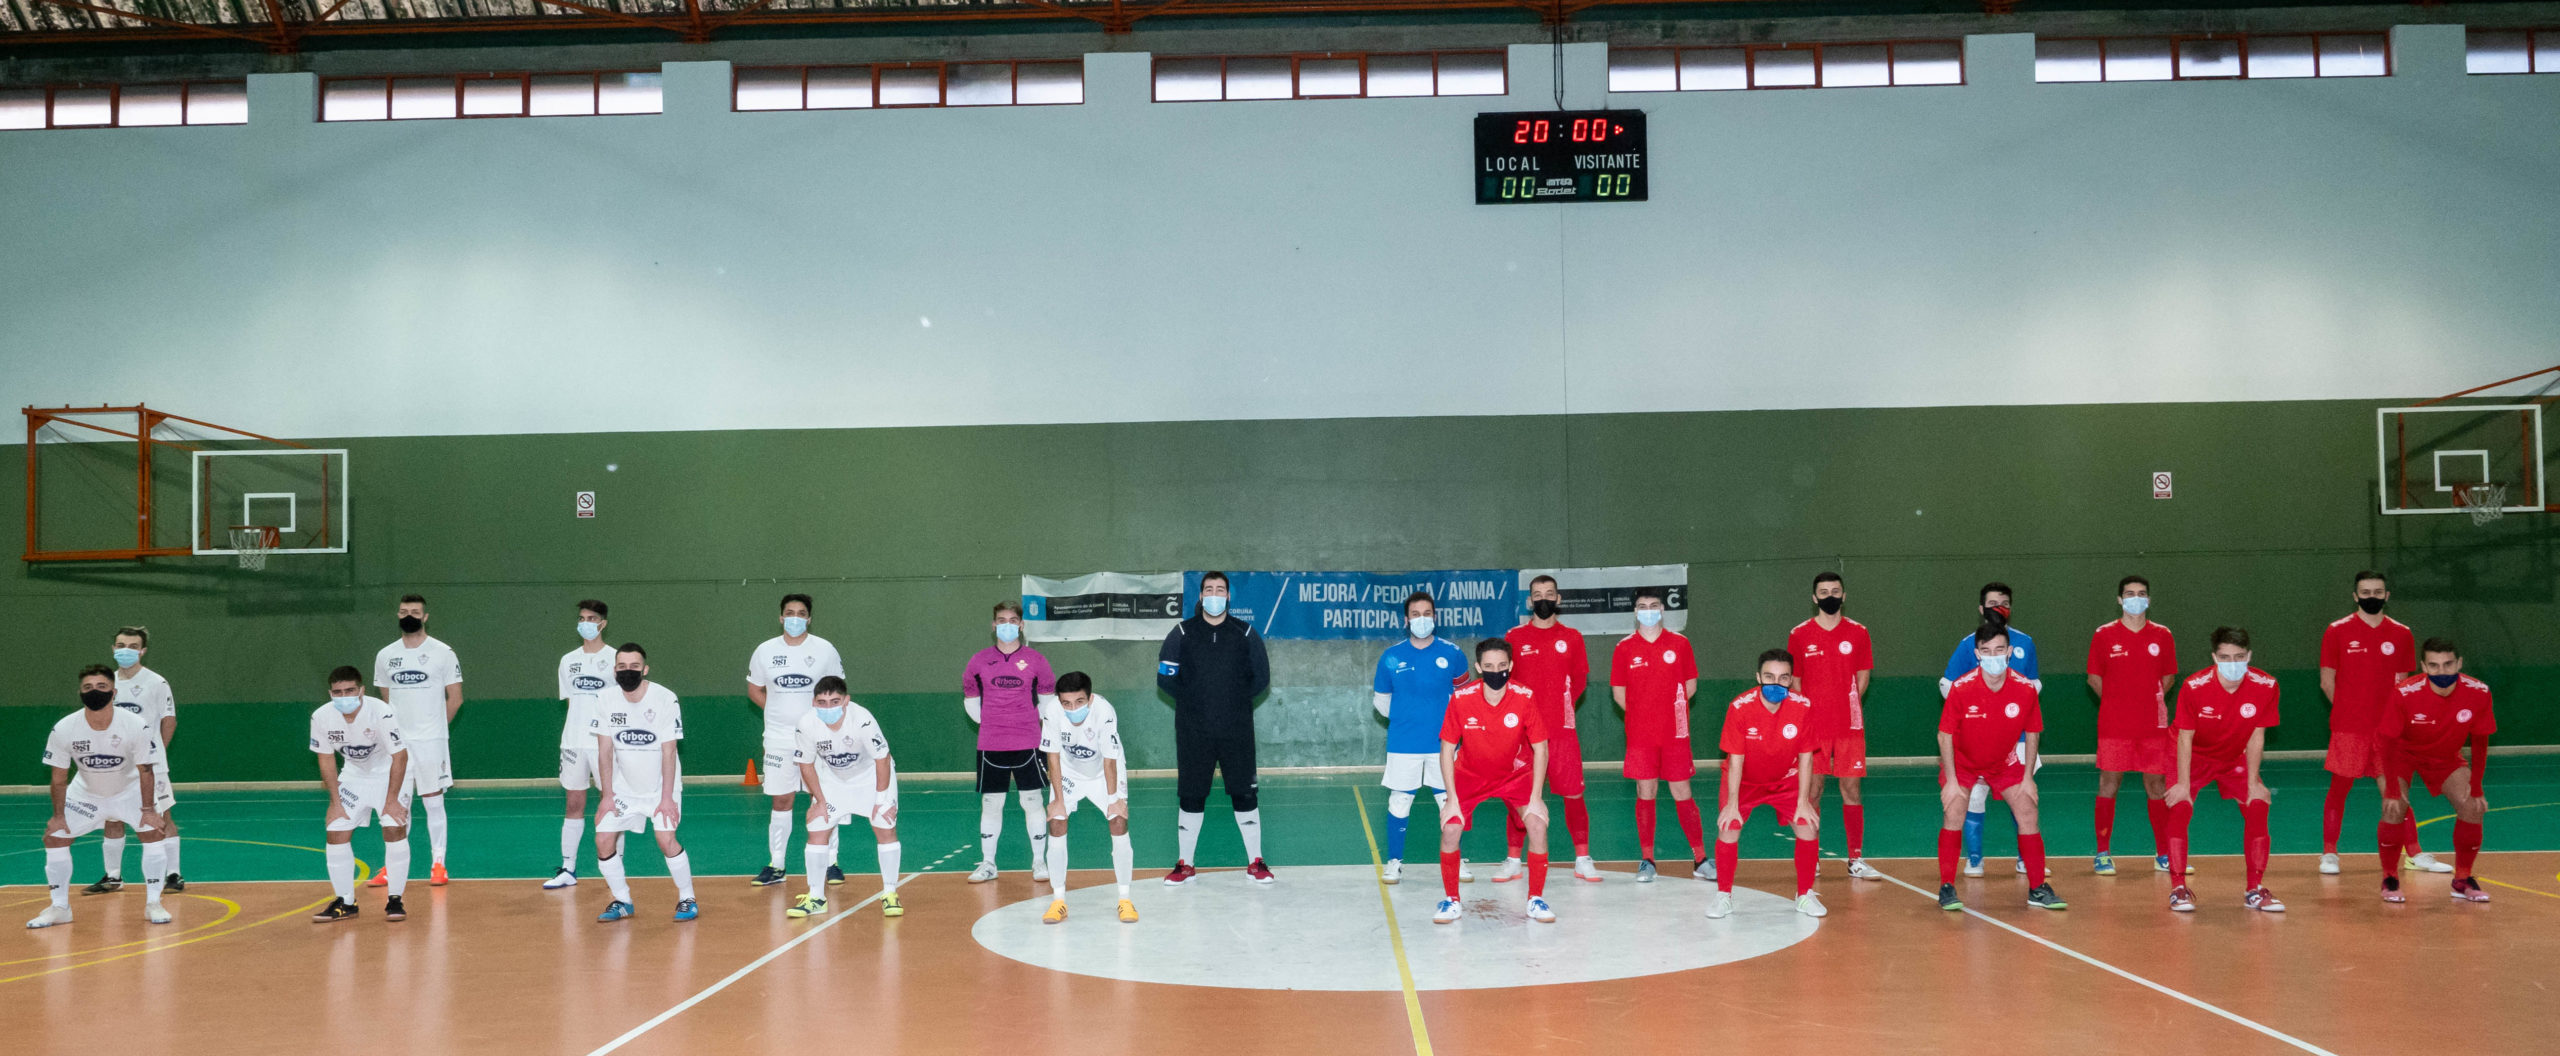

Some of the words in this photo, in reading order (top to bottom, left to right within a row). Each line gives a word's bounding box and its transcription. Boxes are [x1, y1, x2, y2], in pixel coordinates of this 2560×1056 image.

[1485, 156, 1540, 172] LOCAL
[1575, 153, 1640, 169] VISITANTE
[1502, 176, 1536, 199] 00
[1597, 174, 1630, 196] 00
[1299, 583, 1357, 602] MEJORA
[1449, 581, 1495, 600] ANIMA
[1323, 609, 1399, 628] PARTICIPA
[1434, 607, 1483, 626] TRENA
[574, 678, 603, 688] Arboco
[777, 676, 810, 687] Arboco
[620, 731, 654, 744] Arboco
[82, 756, 121, 768] Arboco
